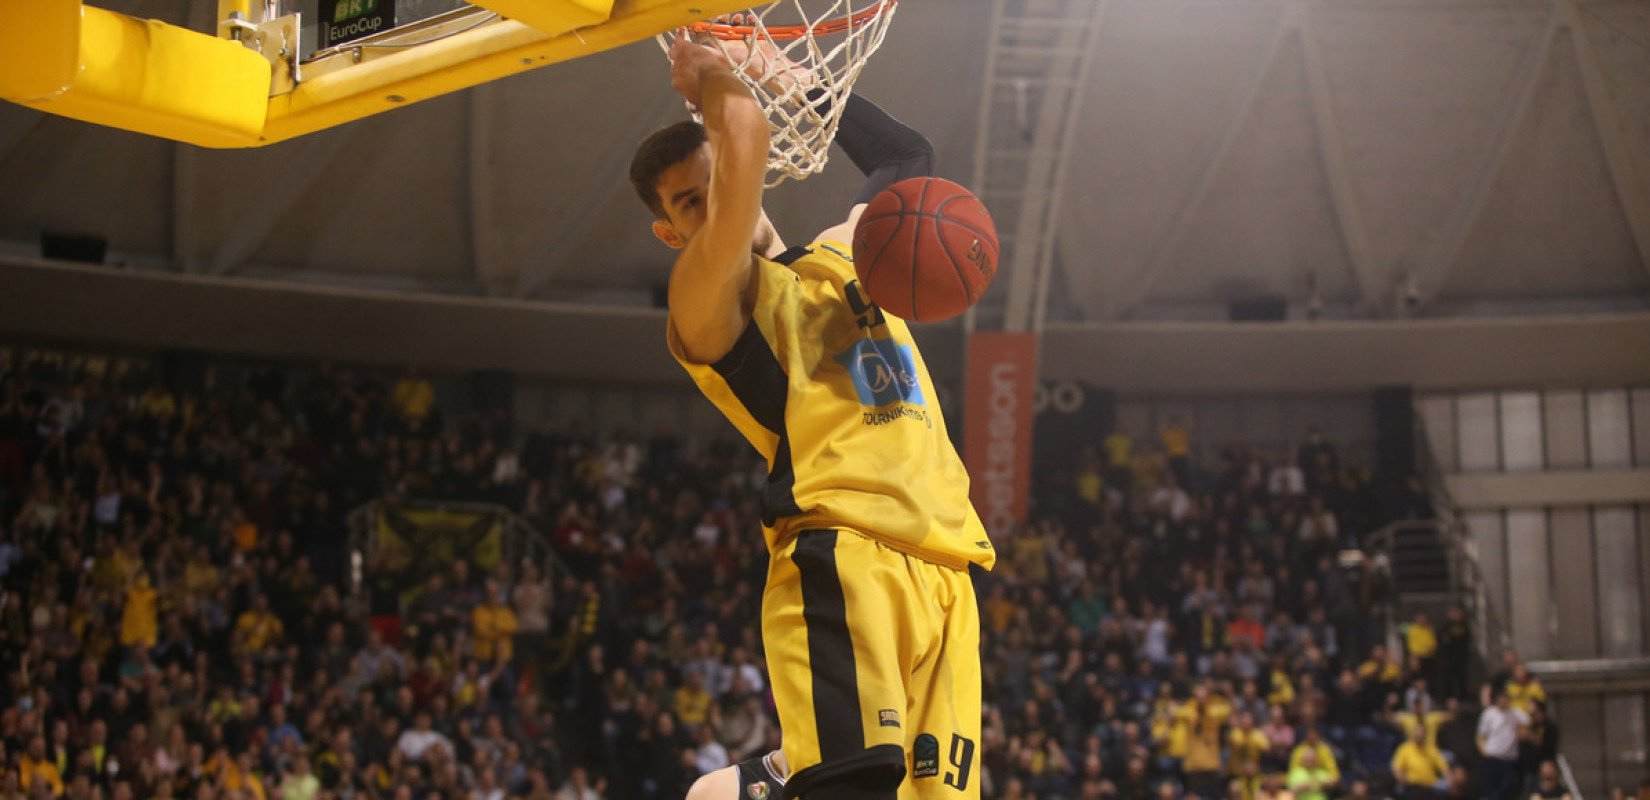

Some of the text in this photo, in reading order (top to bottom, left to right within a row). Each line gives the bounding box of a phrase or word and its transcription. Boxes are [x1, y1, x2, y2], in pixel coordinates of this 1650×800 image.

[330, 16, 382, 41] EuroCup
[844, 279, 887, 330] 9
[943, 732, 975, 792] 9
